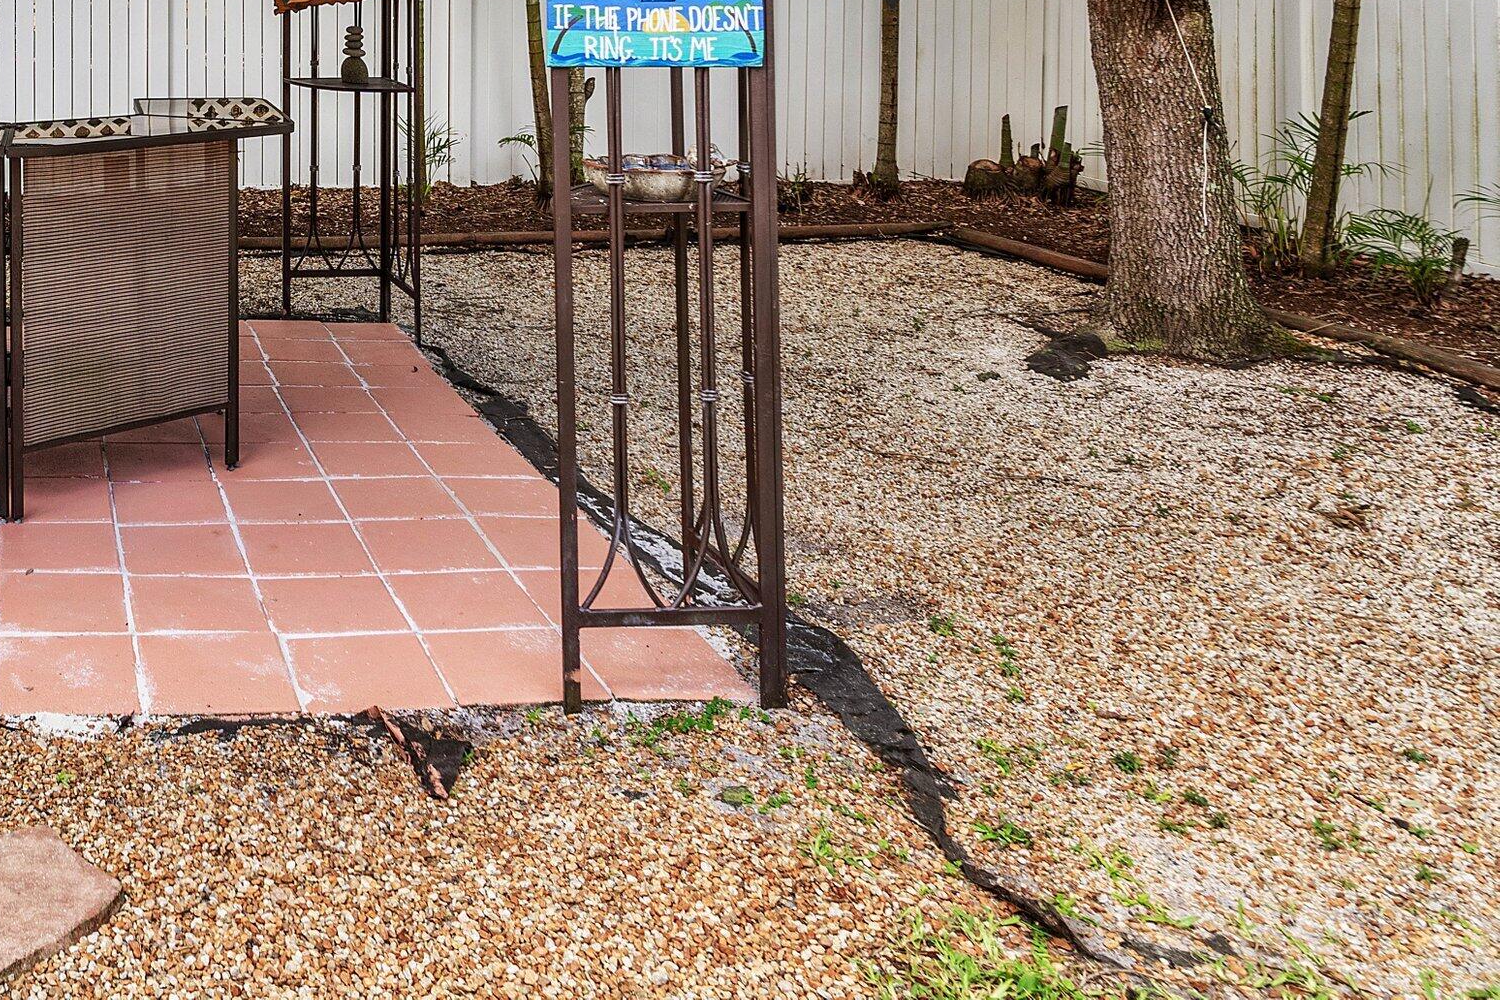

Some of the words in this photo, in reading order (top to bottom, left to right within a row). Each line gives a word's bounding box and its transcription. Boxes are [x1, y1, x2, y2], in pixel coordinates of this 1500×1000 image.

[552, 4, 575, 30] IF
[580, 4, 621, 31] THE
[627, 6, 689, 33] PHONE
[688, 3, 764, 32] DOESN'T
[690, 37, 719, 62] ME
